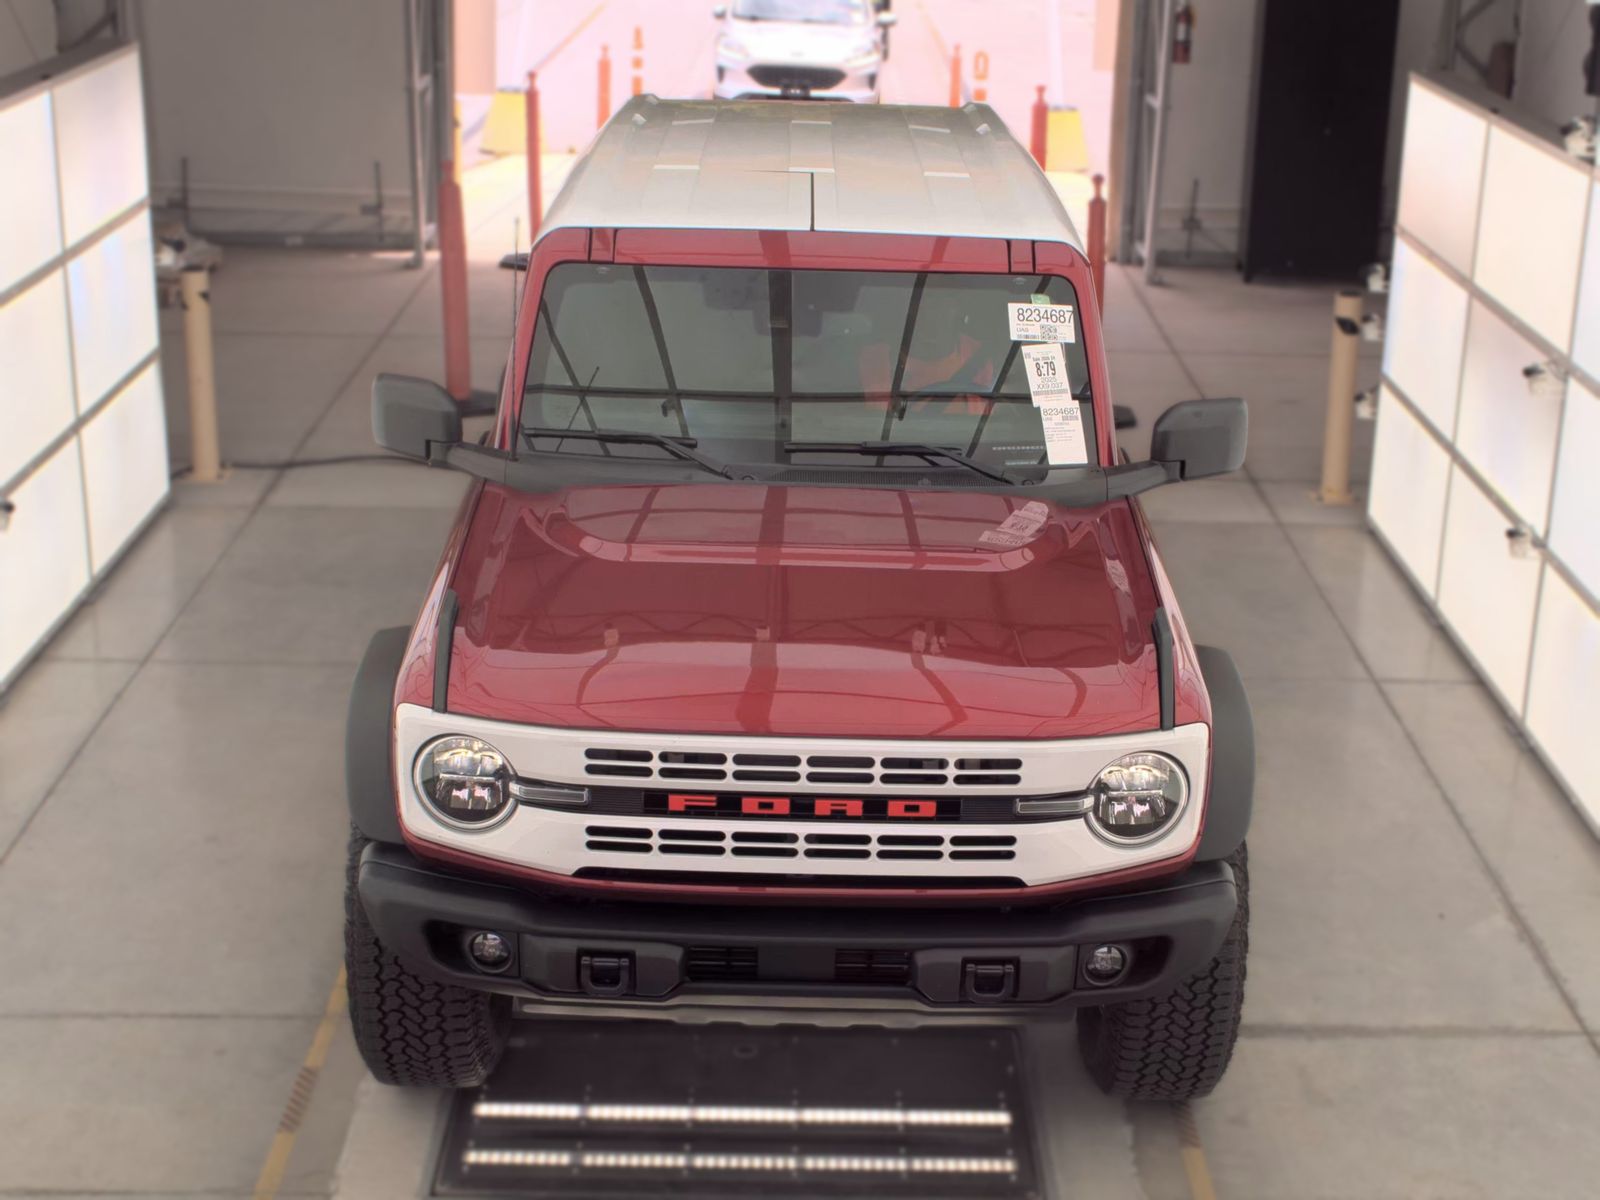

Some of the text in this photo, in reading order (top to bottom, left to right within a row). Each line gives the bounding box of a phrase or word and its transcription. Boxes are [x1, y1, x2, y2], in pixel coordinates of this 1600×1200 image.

[1017, 307, 1074, 324] 8234687
[1042, 407, 1079, 416] 8234687
[668, 794, 937, 817] FORD
